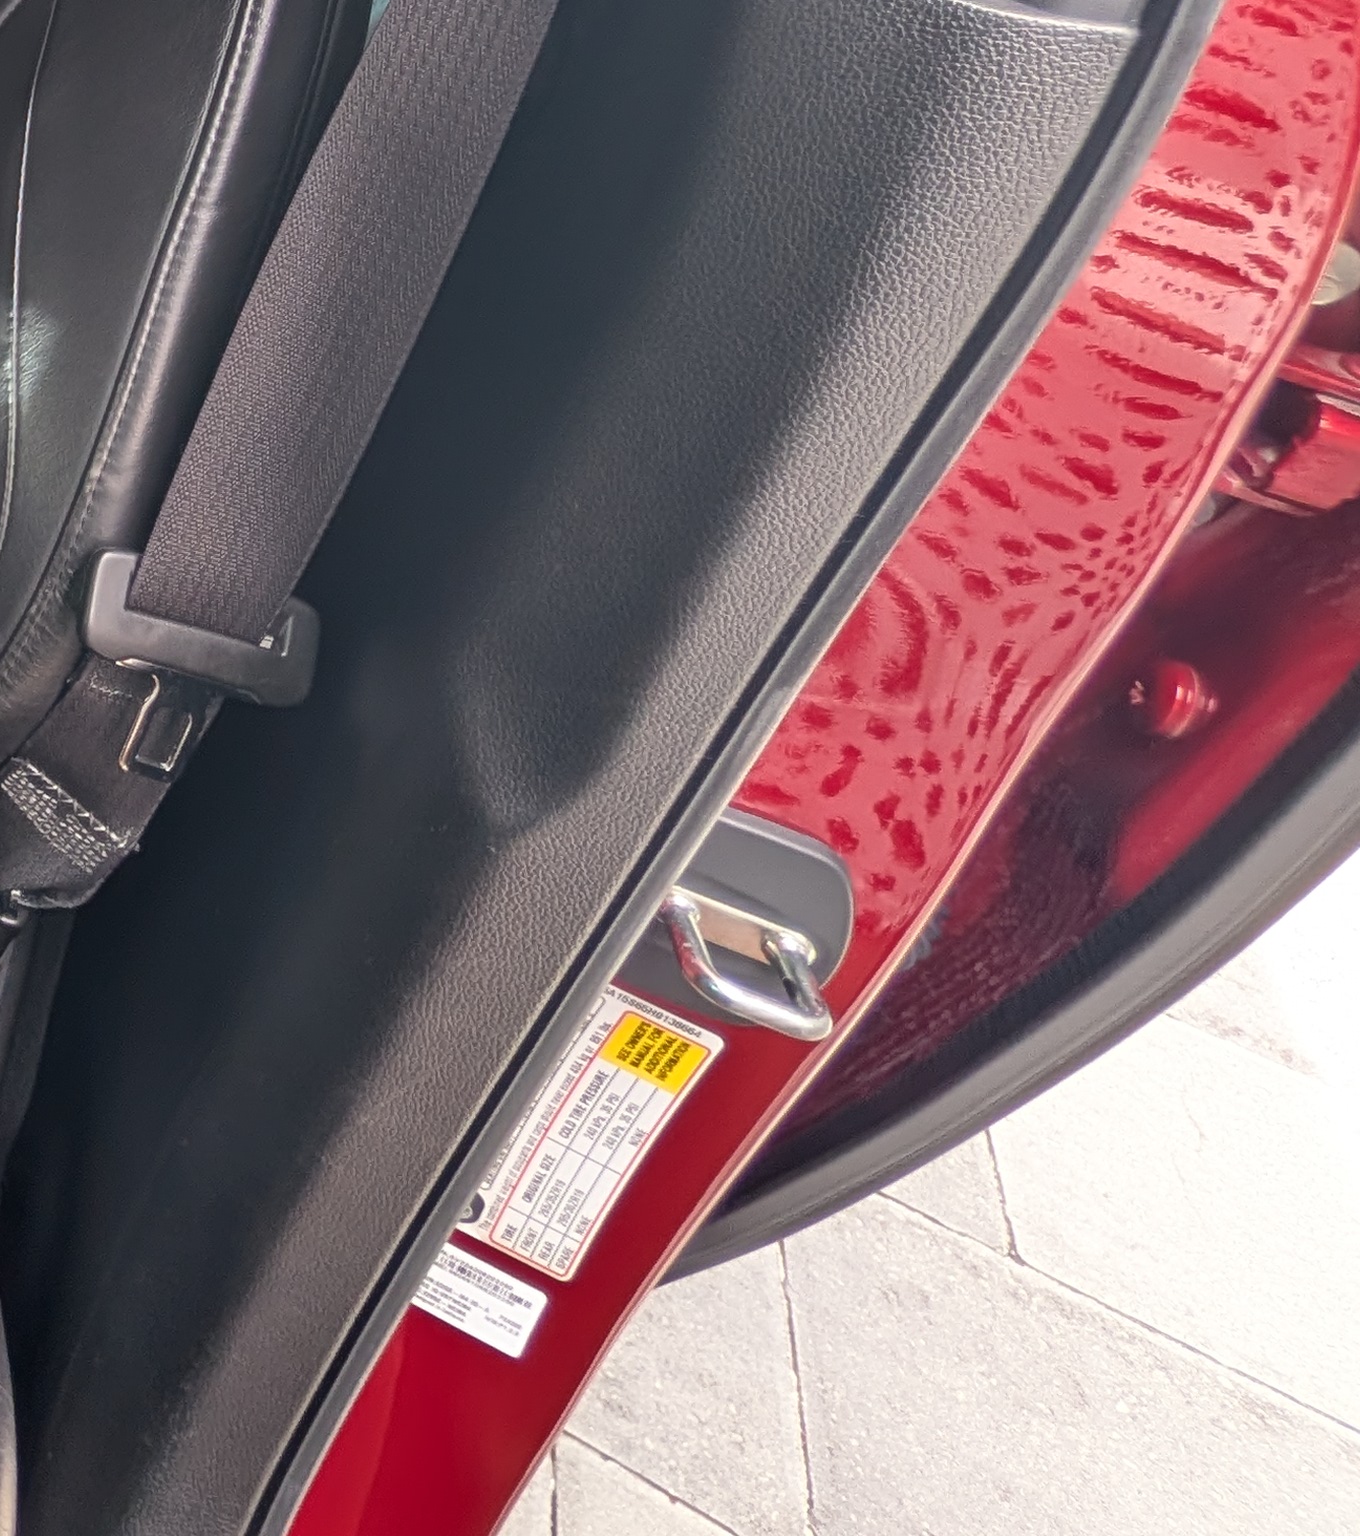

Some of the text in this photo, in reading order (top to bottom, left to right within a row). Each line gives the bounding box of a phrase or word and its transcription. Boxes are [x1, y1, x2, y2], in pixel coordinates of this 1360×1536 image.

[615, 1046, 632, 1063] SEE
[628, 1025, 665, 1069] MANUAL FOR
[642, 1033, 678, 1075] ADDITIONAL
[654, 1039, 691, 1082] INFORMATION
[499, 1067, 609, 1243] TIRE ORIGINAL SIZE COLD TIRE PRESSURE
[518, 1226, 539, 1253] FRONT
[604, 1090, 622, 1106] PSI
[554, 1126, 647, 1270] SPARE NONE NONE
[536, 1238, 555, 1261] REAR
